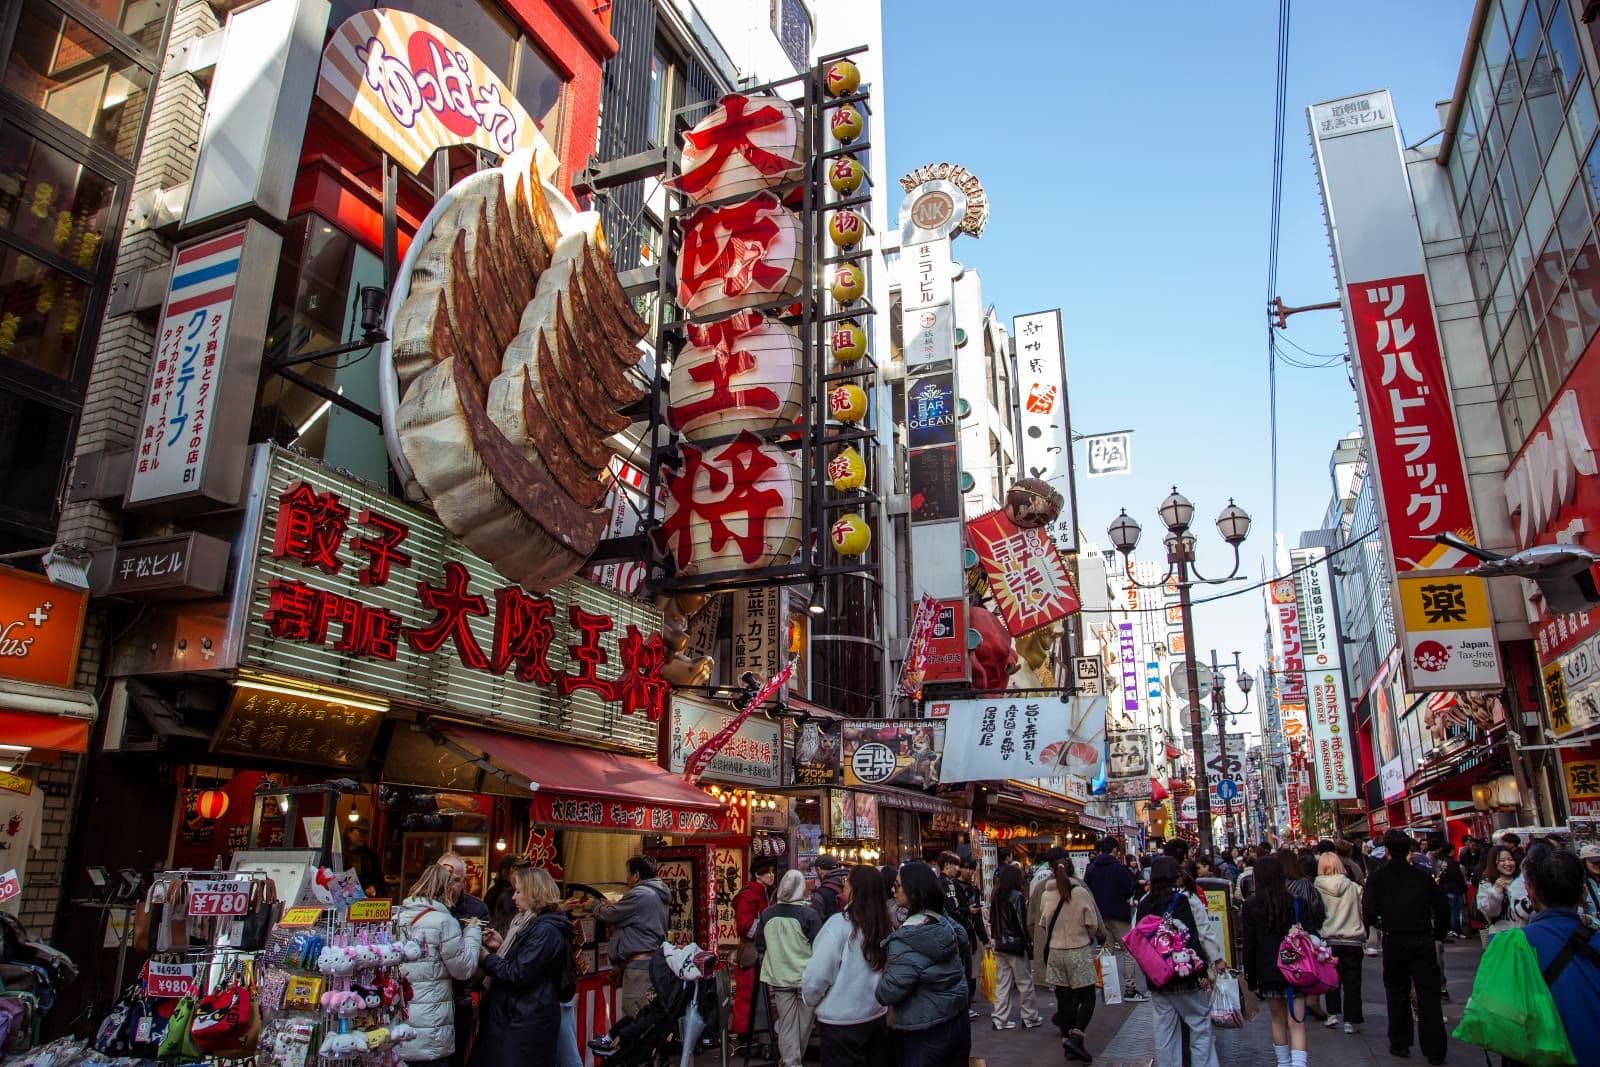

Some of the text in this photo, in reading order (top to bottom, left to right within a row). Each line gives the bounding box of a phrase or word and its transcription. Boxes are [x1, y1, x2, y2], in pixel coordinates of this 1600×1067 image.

[1321, 109, 1386, 132] 法善寺ビル
[920, 201, 945, 221] NK
[651, 93, 807, 571] 大阪王将
[168, 309, 208, 447] クンテープ
[186, 314, 222, 465] タイ料理とタイスキの店
[150, 325, 185, 471] タイカルチャースクール
[918, 400, 944, 413] BAR
[1366, 284, 1448, 531] ツルハドラッグ
[910, 415, 954, 429] OCEAN
[183, 467, 196, 483] B1
[273, 480, 412, 587] 餃子
[120, 551, 183, 580] 平松ビル
[767, 586, 777, 645] MESHIBA
[1420, 583, 1468, 624] 薬
[402, 561, 670, 722] 大阪王将
[1280, 606, 1304, 692] ジャンカラ
[1458, 651, 1493, 659] Tax-free
[1460, 640, 1489, 651] Japan
[1473, 660, 1495, 669] Shop
[1325, 684, 1339, 725] カラオケ
[979, 706, 997, 746] 居酒屋
[1208, 773, 1243, 783] KRA
[1320, 740, 1333, 791] MANEKINEKO
[1570, 764, 1600, 794] 薬
[552, 797, 604, 822] 大阪王将
[679, 812, 719, 829] GYOZA
[194, 894, 246, 913] ¥780
[158, 980, 188, 993] ¥980
